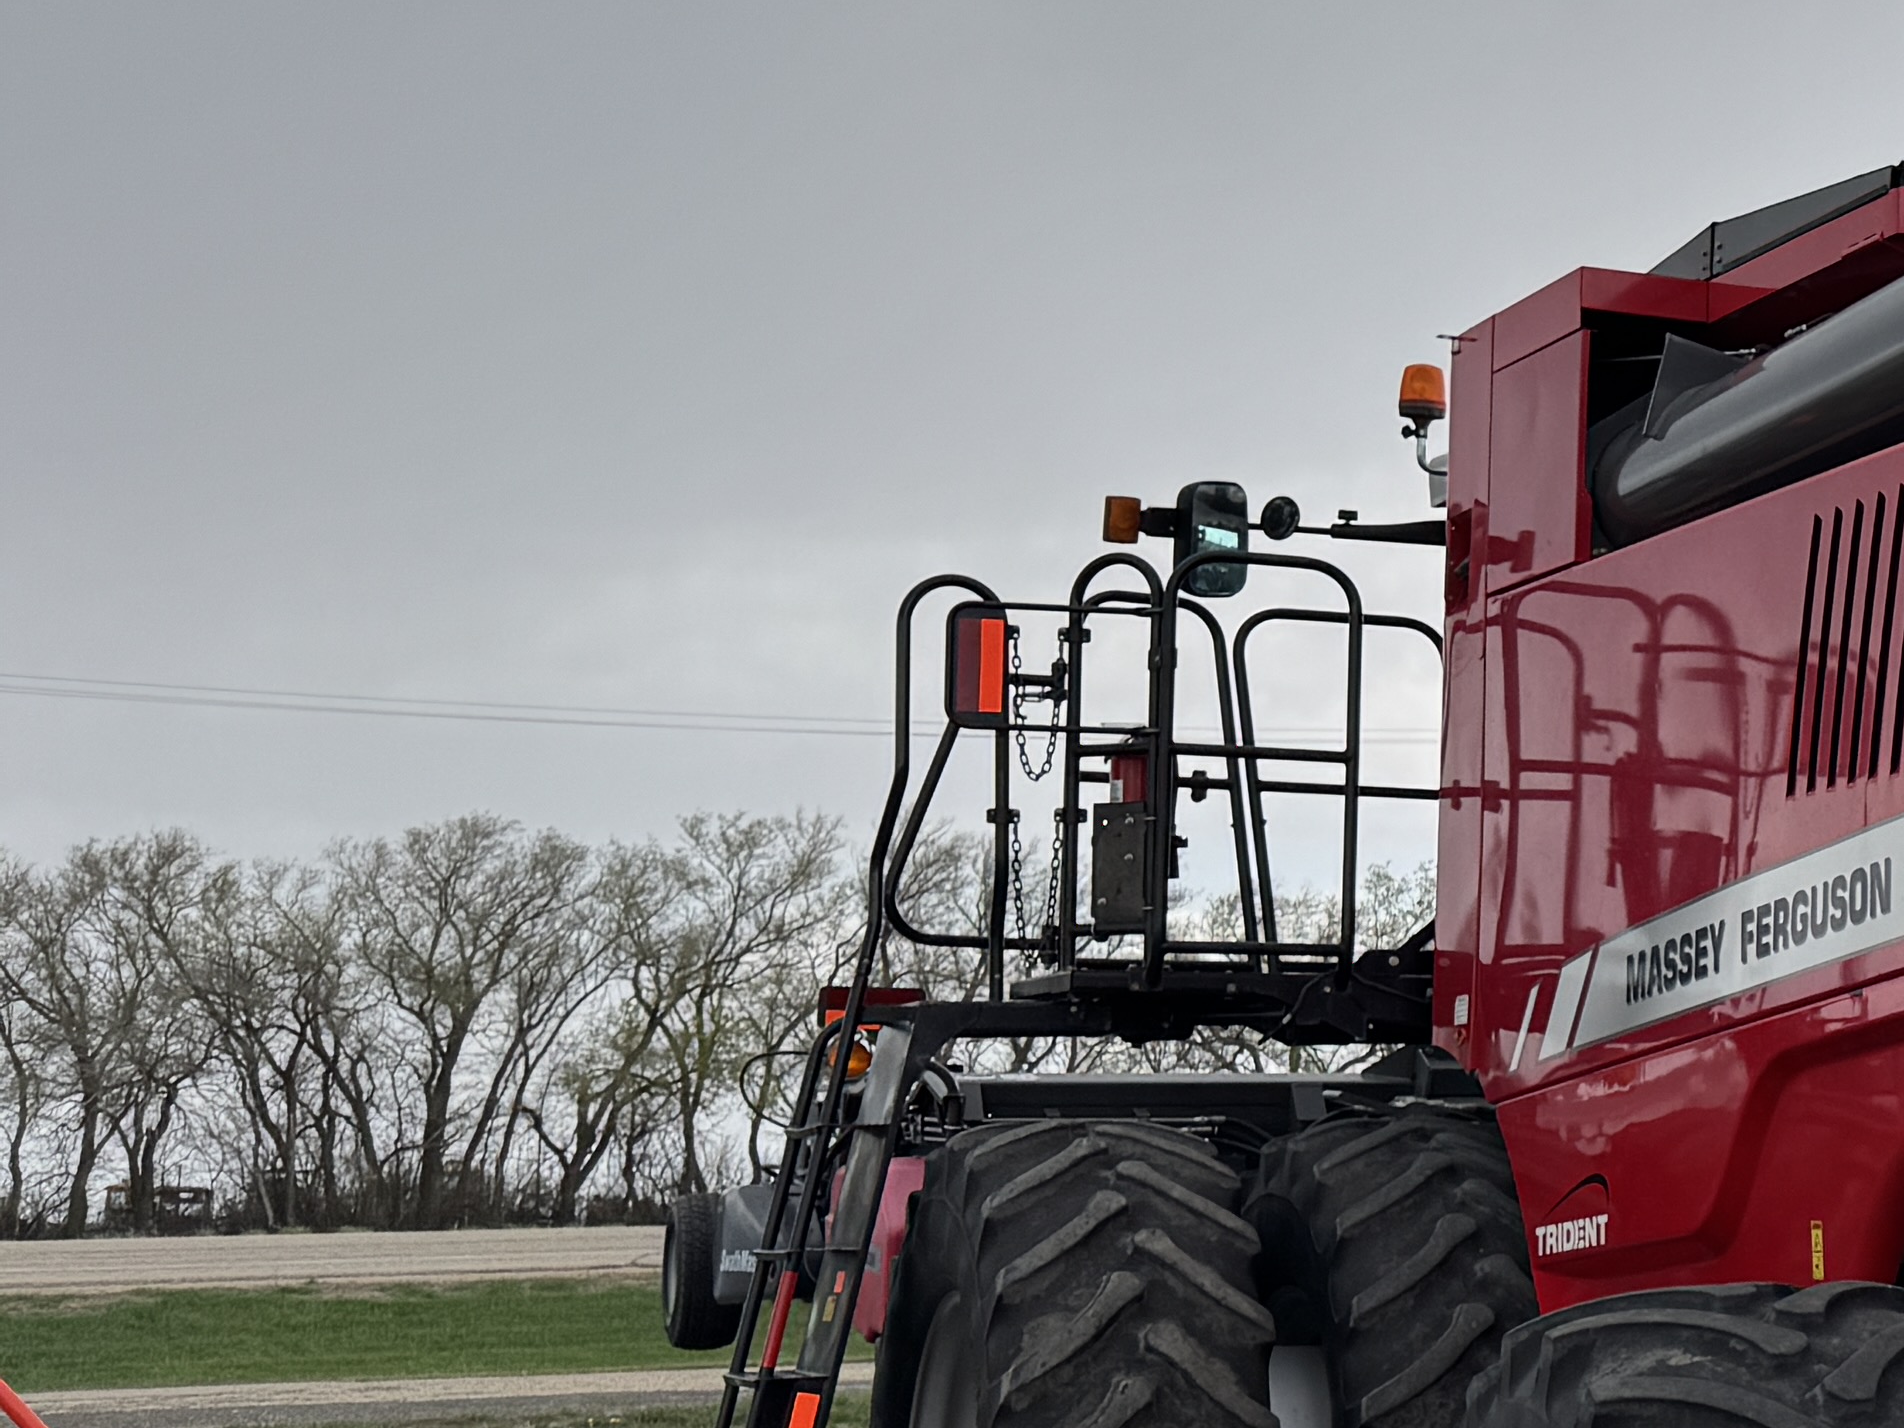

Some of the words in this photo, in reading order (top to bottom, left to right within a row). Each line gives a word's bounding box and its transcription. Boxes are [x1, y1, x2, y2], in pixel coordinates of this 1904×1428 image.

[1625, 918, 1726, 1006] MASSEY
[1741, 856, 1892, 965] FERGUSON
[1535, 1213, 1609, 1257] TRIDENT
